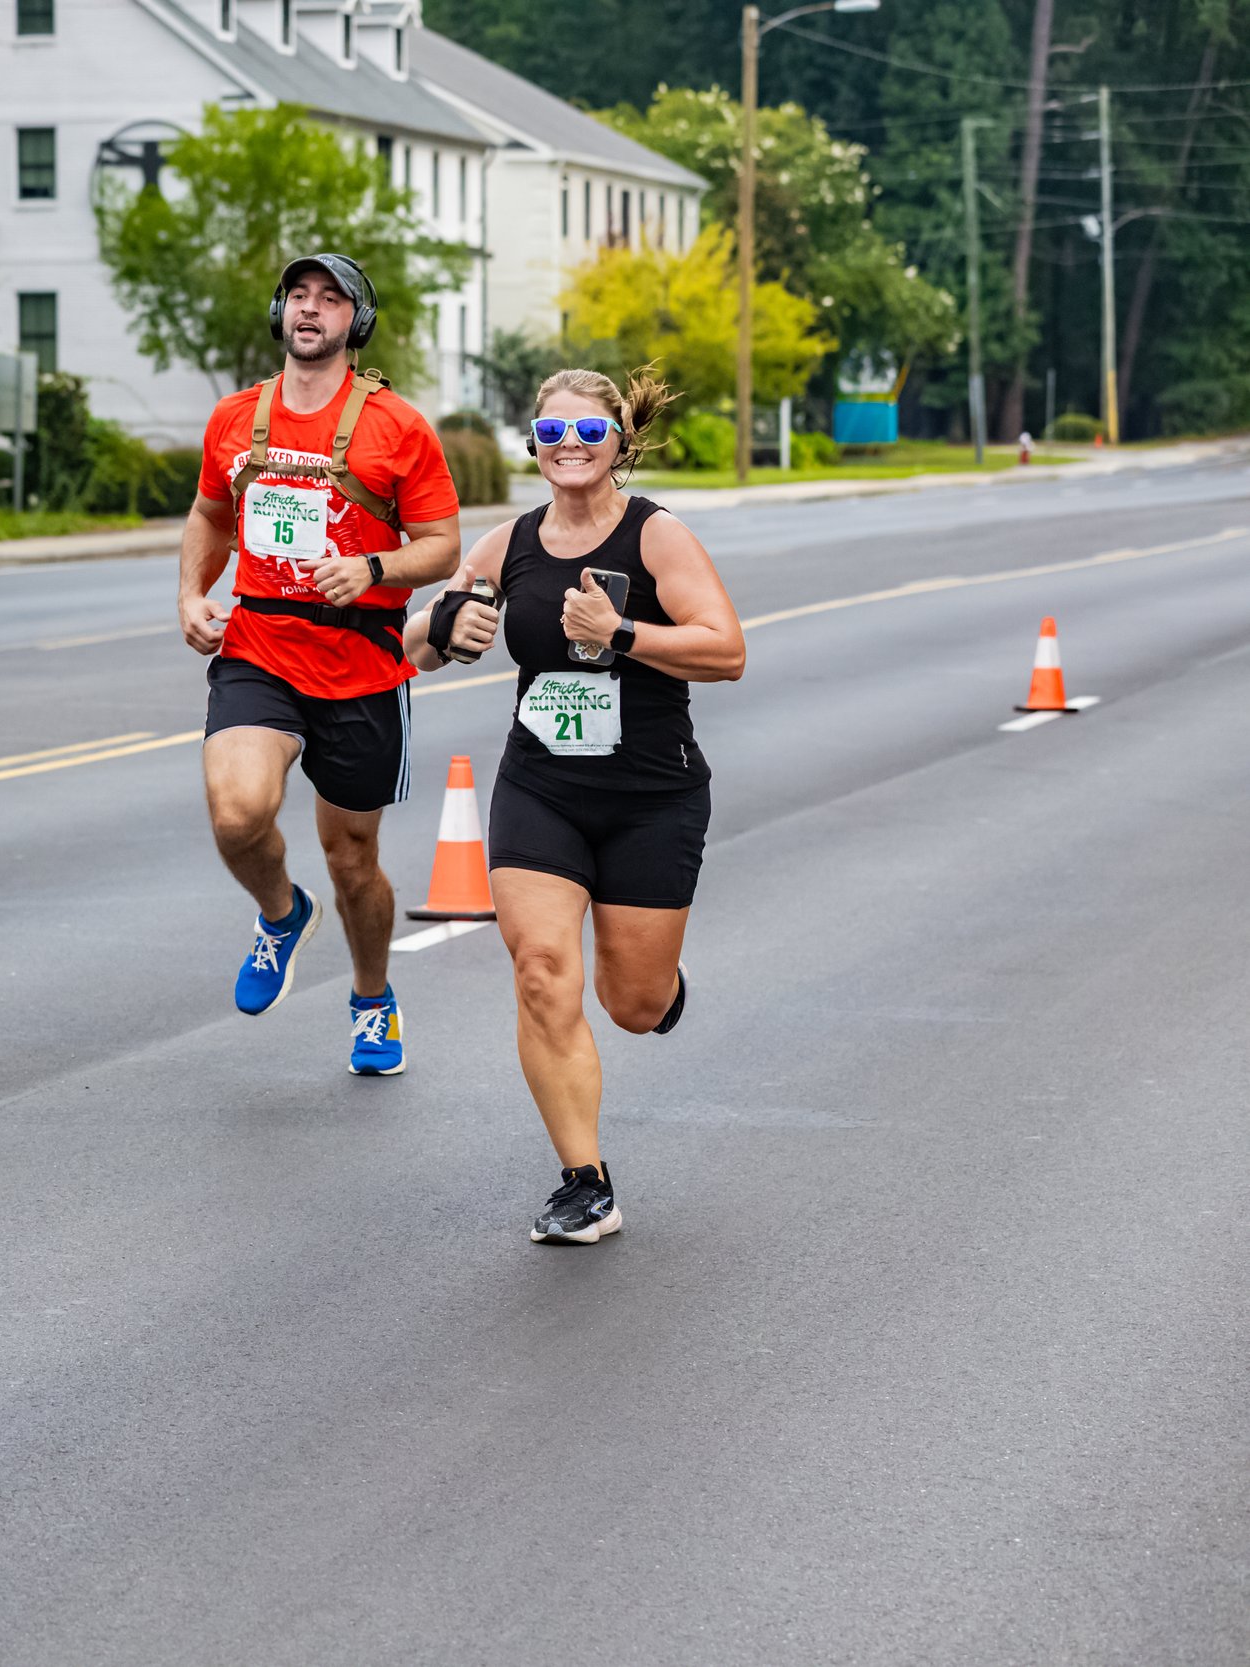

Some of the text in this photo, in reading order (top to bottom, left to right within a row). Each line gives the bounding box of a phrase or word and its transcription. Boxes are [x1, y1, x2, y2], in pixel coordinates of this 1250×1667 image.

[238, 451, 293, 467] BEVED
[262, 491, 306, 508] Strictly
[253, 502, 319, 521] RUNNING
[272, 520, 294, 545] 15
[281, 585, 309, 597] JOHN
[540, 680, 595, 700] Strictly
[529, 694, 612, 711] RUNNING
[555, 713, 583, 740] 21
